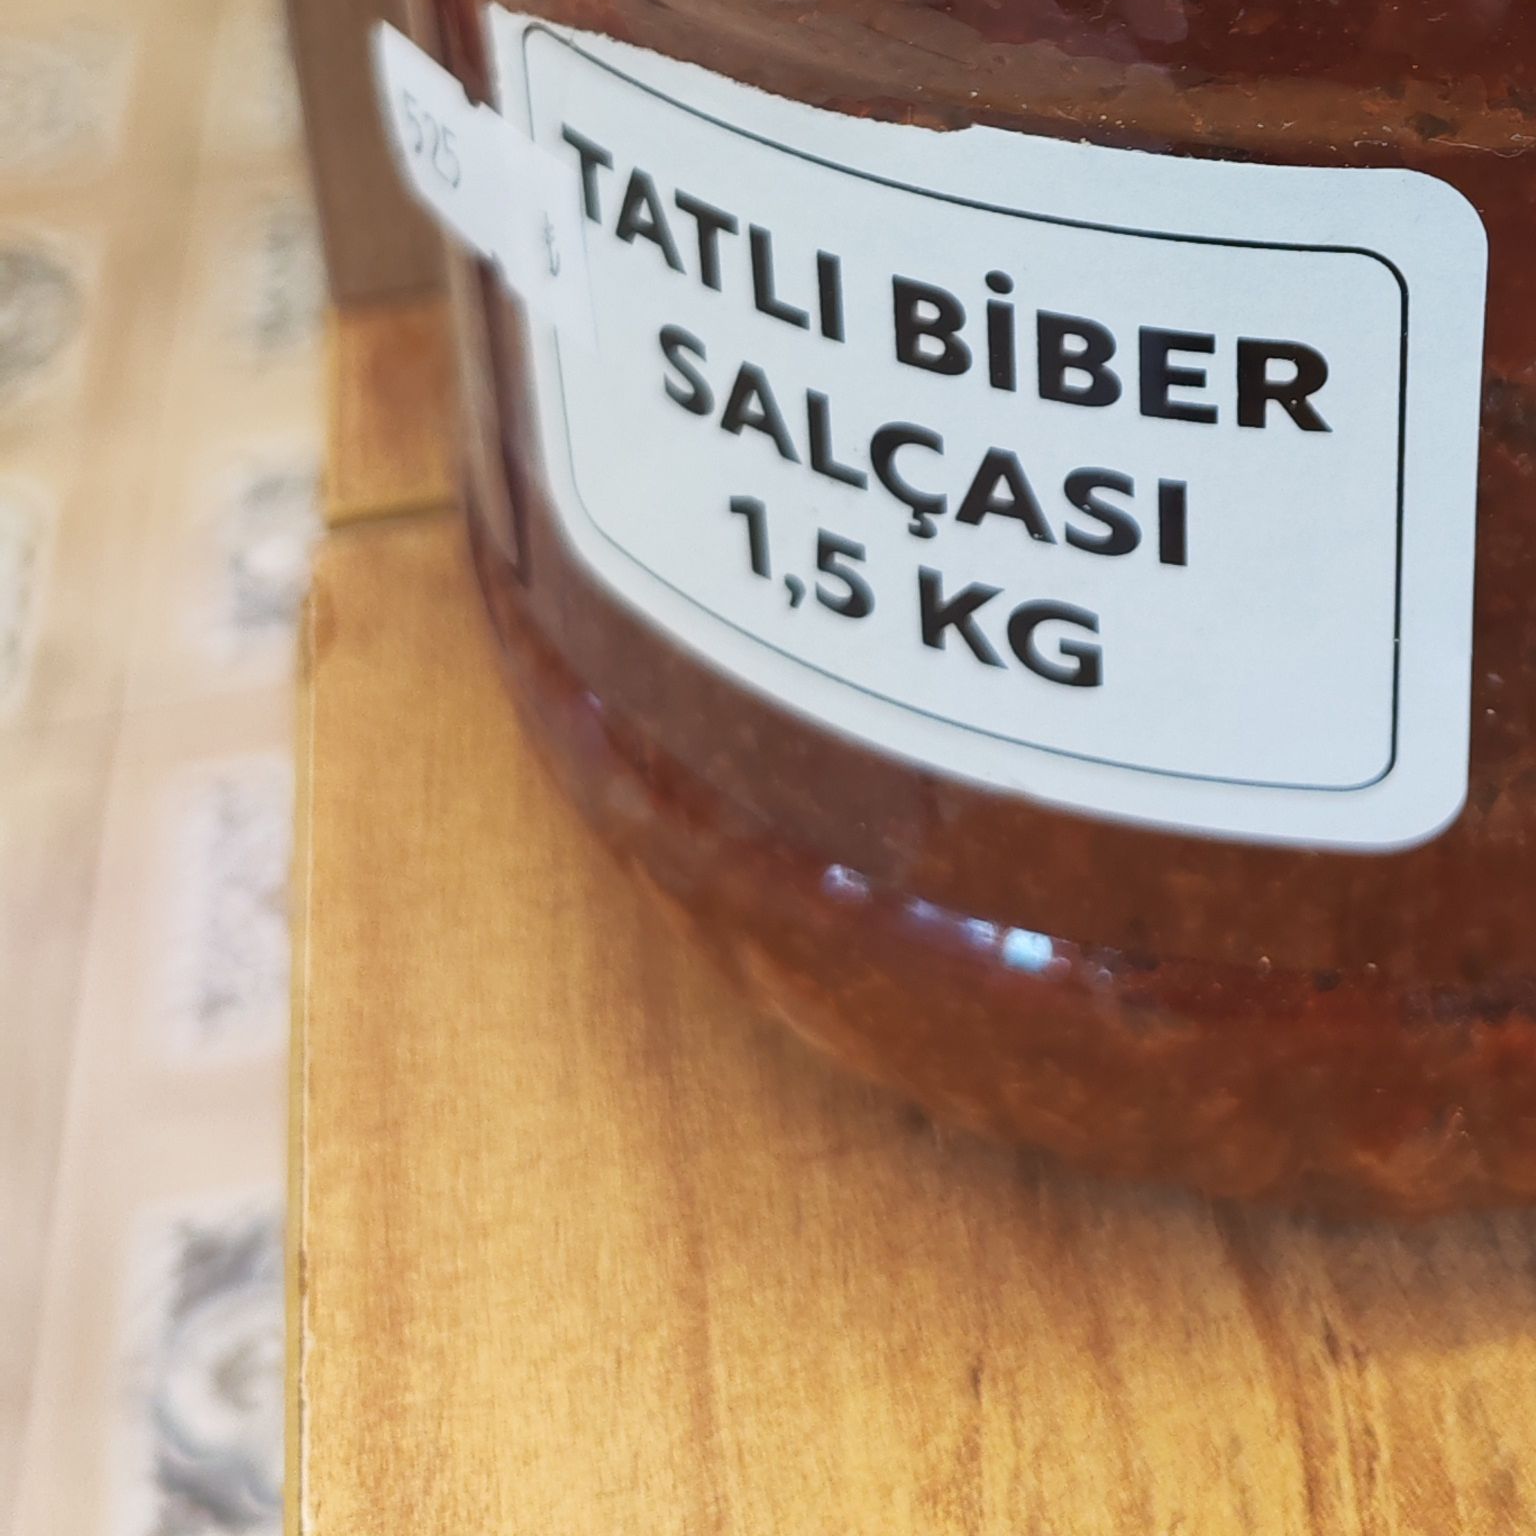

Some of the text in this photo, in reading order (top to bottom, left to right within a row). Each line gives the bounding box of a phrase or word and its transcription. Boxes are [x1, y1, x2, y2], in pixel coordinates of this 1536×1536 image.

[560, 120, 1332, 433] TATLI BİBER
[658, 325, 1188, 566] SALÇASI
[728, 495, 1103, 687] 1,5 KG
